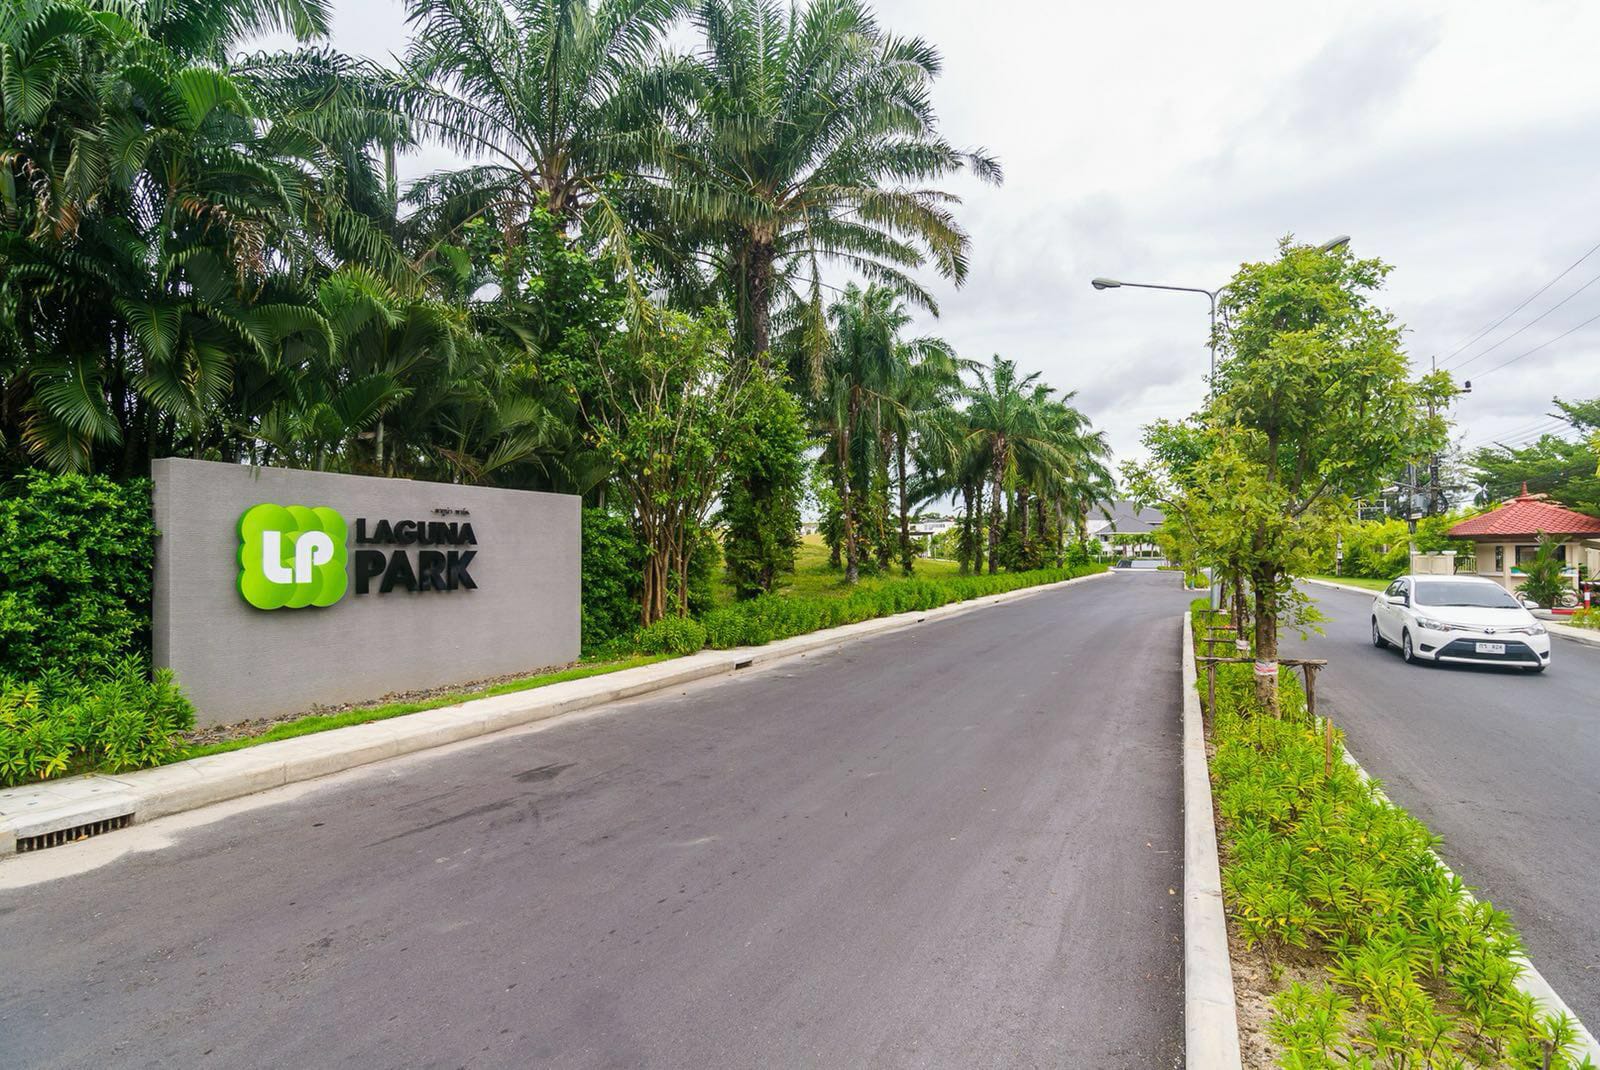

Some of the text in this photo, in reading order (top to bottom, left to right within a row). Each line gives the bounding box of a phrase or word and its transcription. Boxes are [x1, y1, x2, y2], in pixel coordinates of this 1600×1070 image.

[356, 518, 477, 545] LAGUNA
[263, 531, 334, 584] LP
[355, 550, 478, 594] PARK
